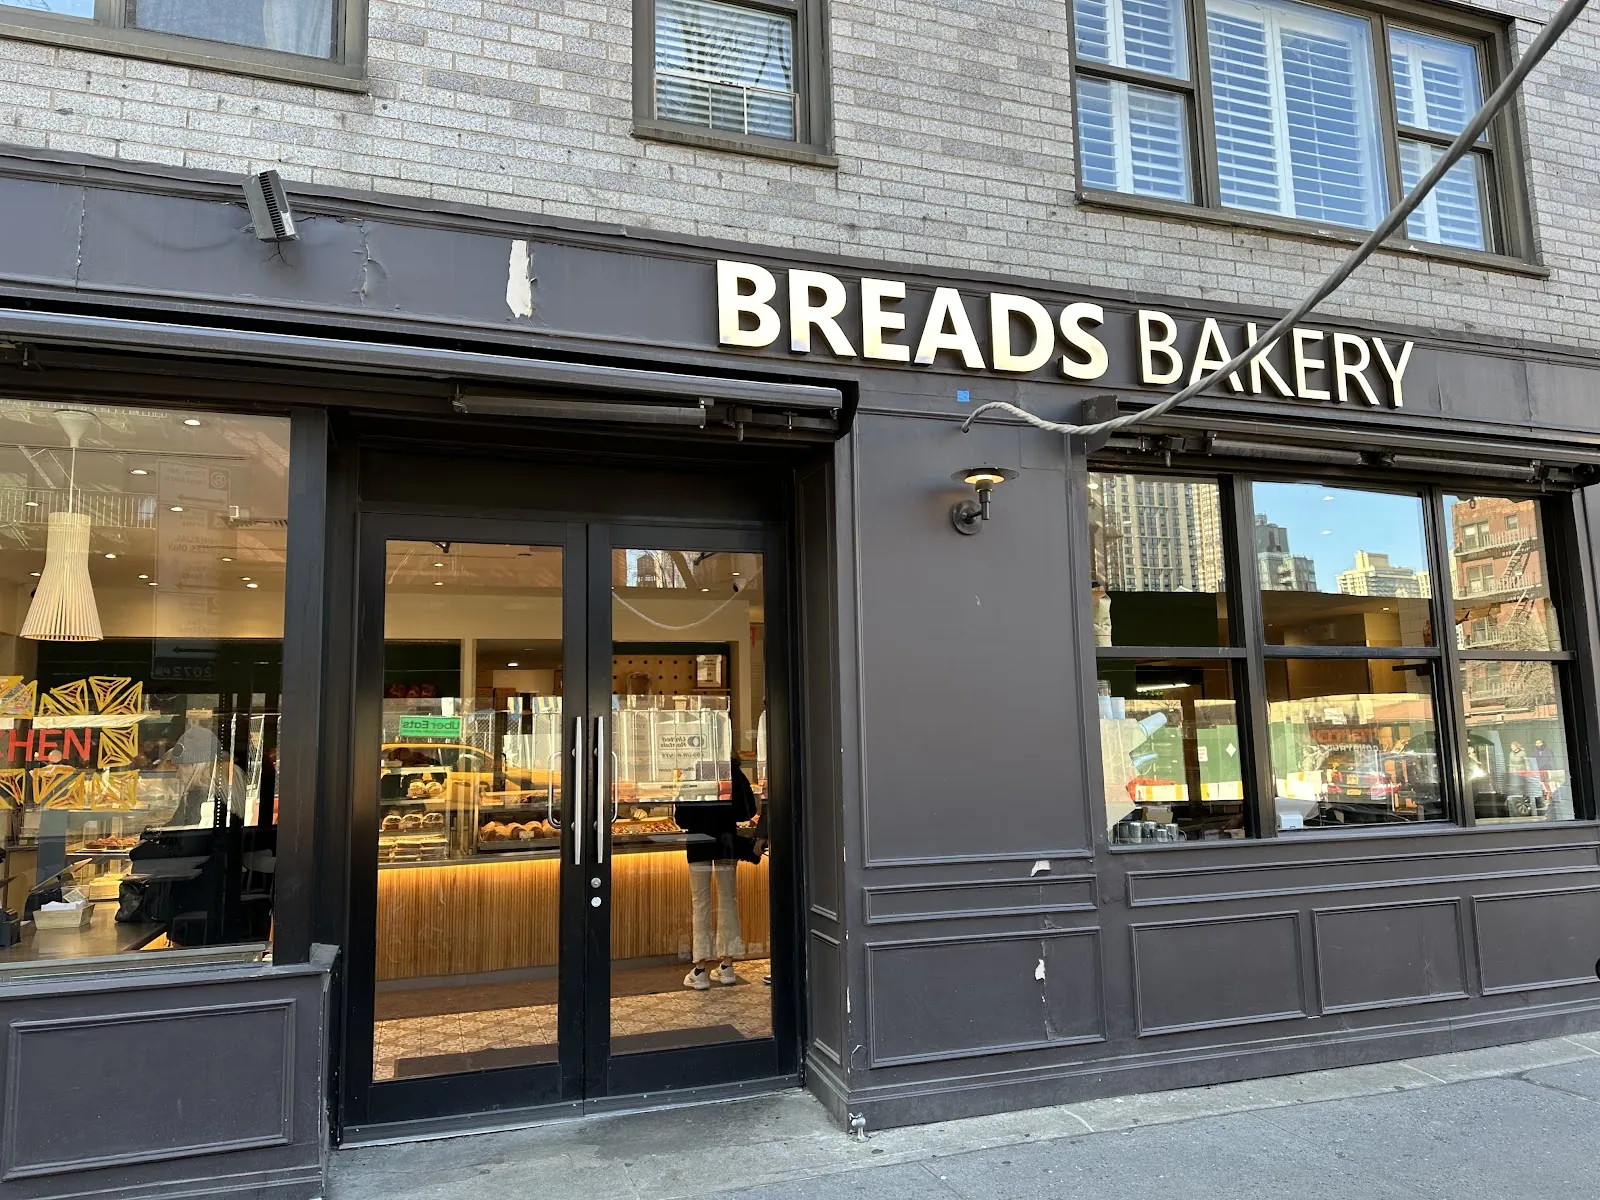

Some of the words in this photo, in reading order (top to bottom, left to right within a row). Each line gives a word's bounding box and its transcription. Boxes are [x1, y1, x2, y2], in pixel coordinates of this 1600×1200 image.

[716, 259, 1109, 380] BREADS
[1137, 309, 1414, 407] BAKERY
[0, 727, 92, 762] HEN
